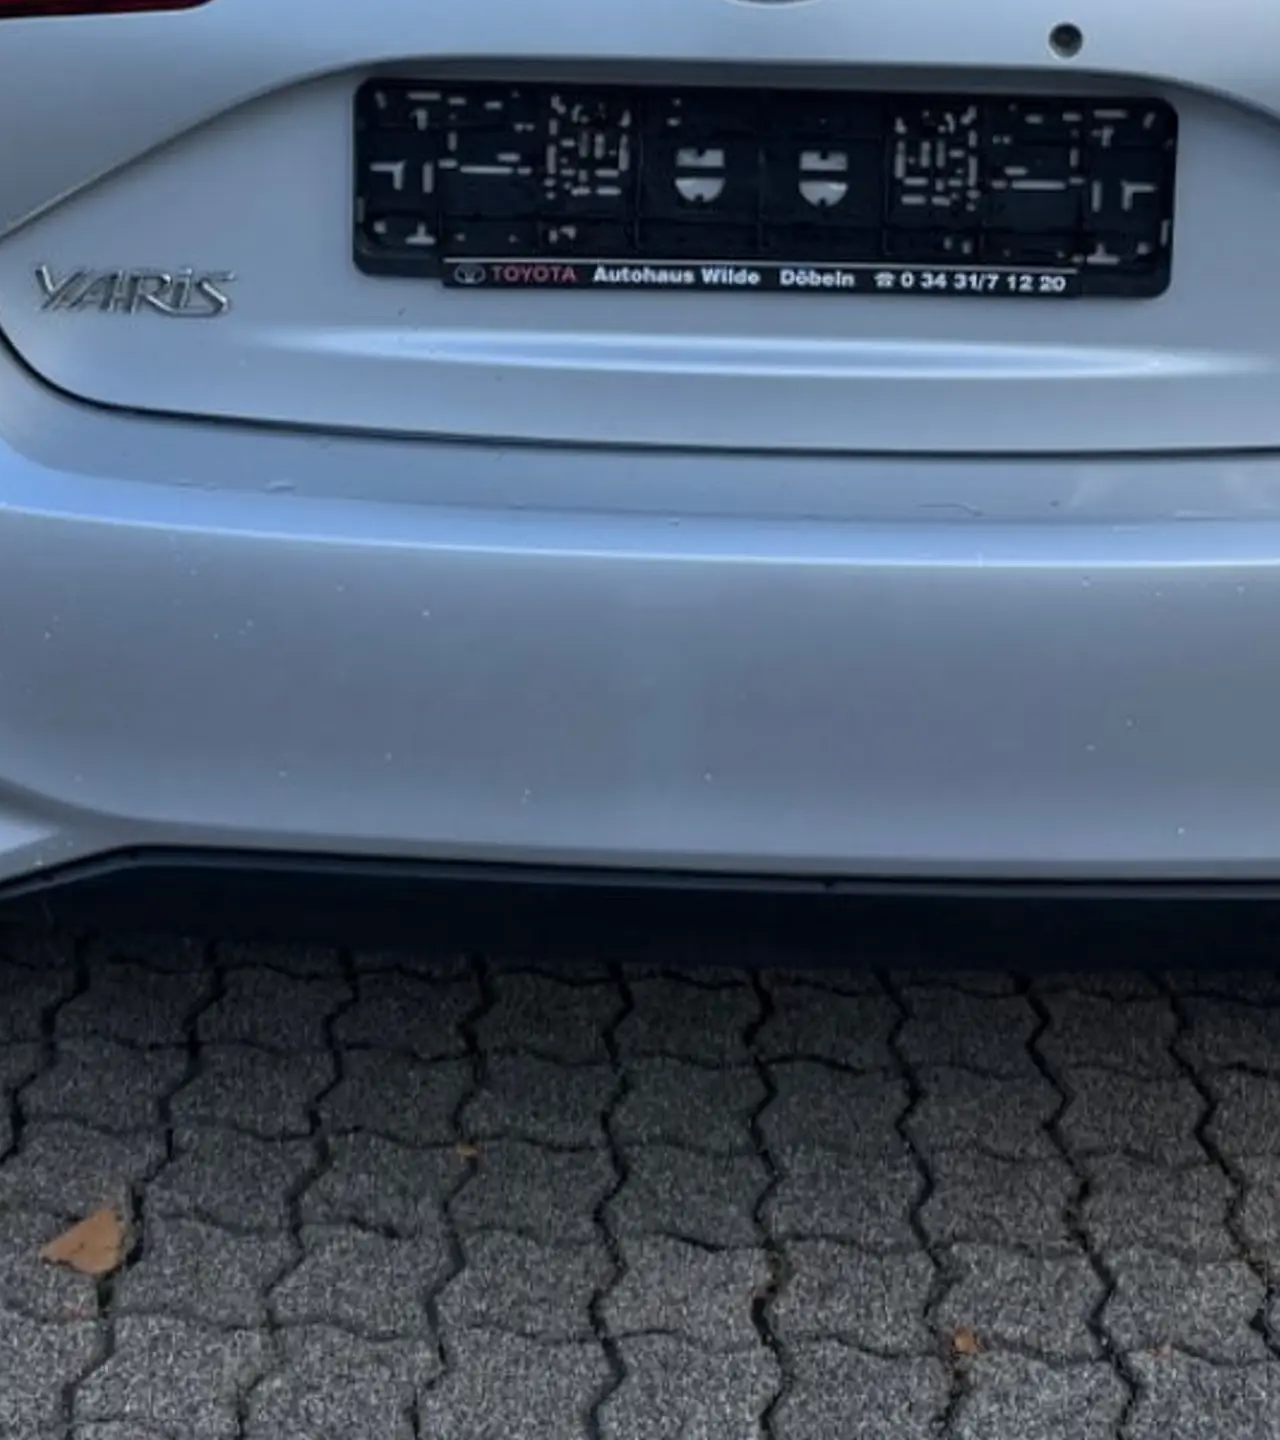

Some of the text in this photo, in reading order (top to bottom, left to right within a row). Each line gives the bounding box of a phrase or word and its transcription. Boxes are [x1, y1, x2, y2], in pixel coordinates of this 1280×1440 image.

[491, 265, 577, 283] TOYOTA
[593, 264, 695, 284] Autohaus
[701, 266, 761, 286] Wilde
[780, 268, 856, 289] Döbeln
[921, 271, 947, 289] 34
